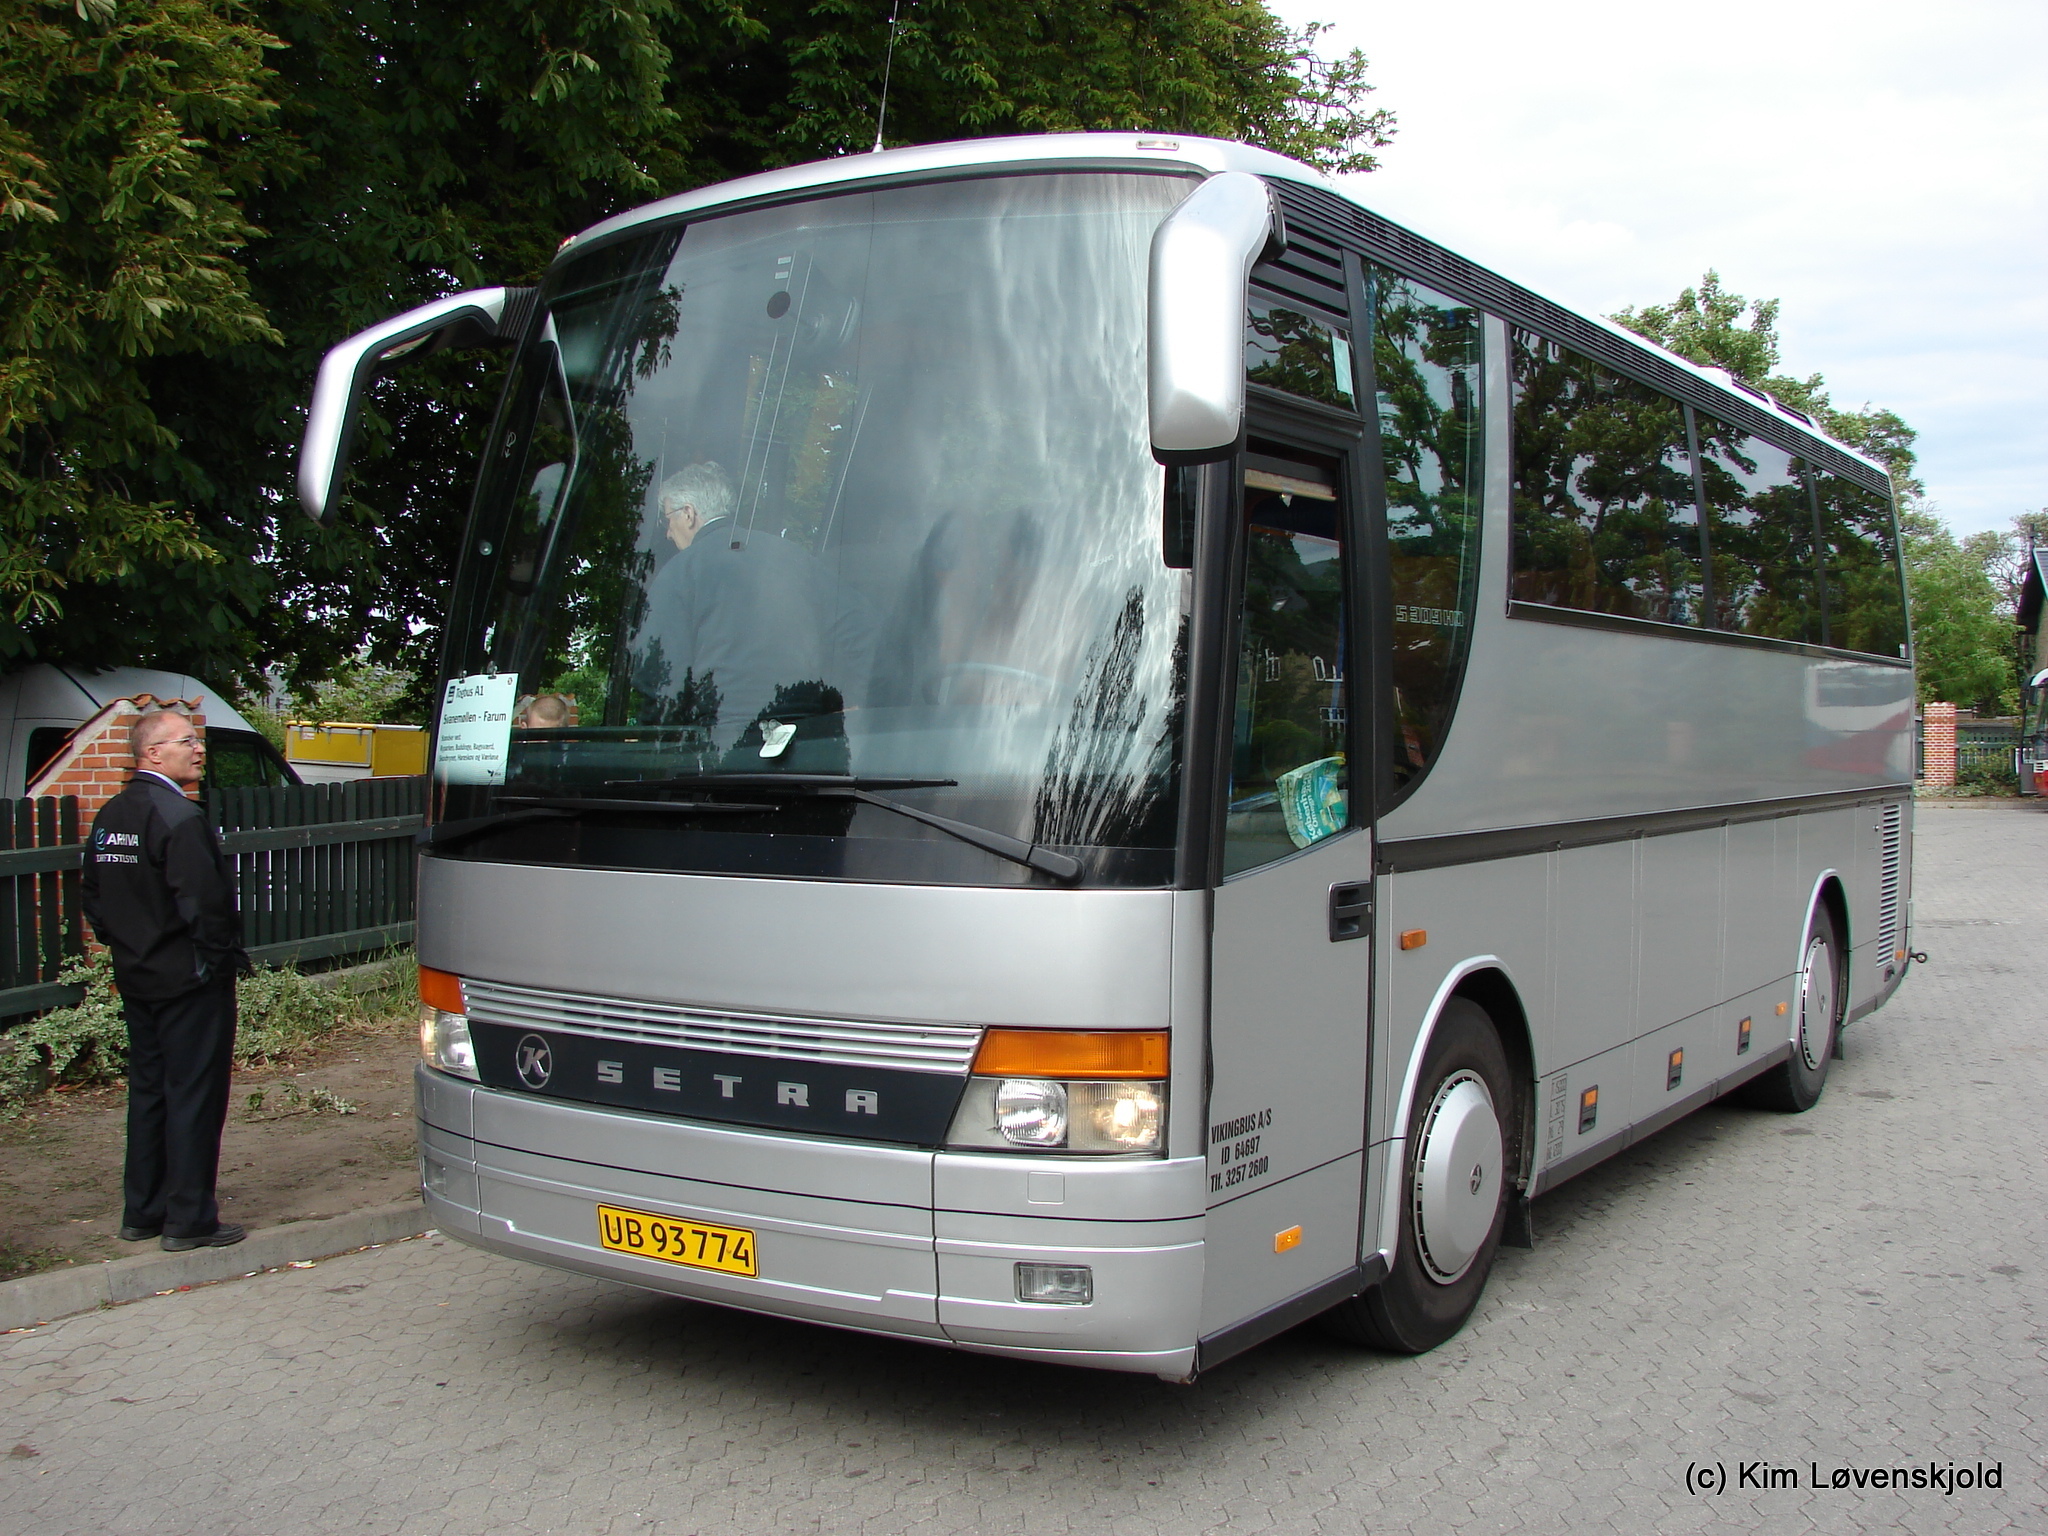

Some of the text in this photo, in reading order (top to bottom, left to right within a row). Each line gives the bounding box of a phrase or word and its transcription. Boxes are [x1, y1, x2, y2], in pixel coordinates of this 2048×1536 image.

[456, 685, 484, 699] Togbus A1
[484, 711, 507, 722] Farum
[1307, 795, 1319, 828] Omegn
[106, 833, 139, 847] ARRIVA
[597, 1060, 878, 1115] SETRA
[1211, 1108, 1272, 1145] VIKINGBUS A/S
[1221, 1135, 1261, 1165] ID 64697
[1210, 1155, 1269, 1193] Tlf. 3257 2600
[604, 1214, 645, 1248] UB
